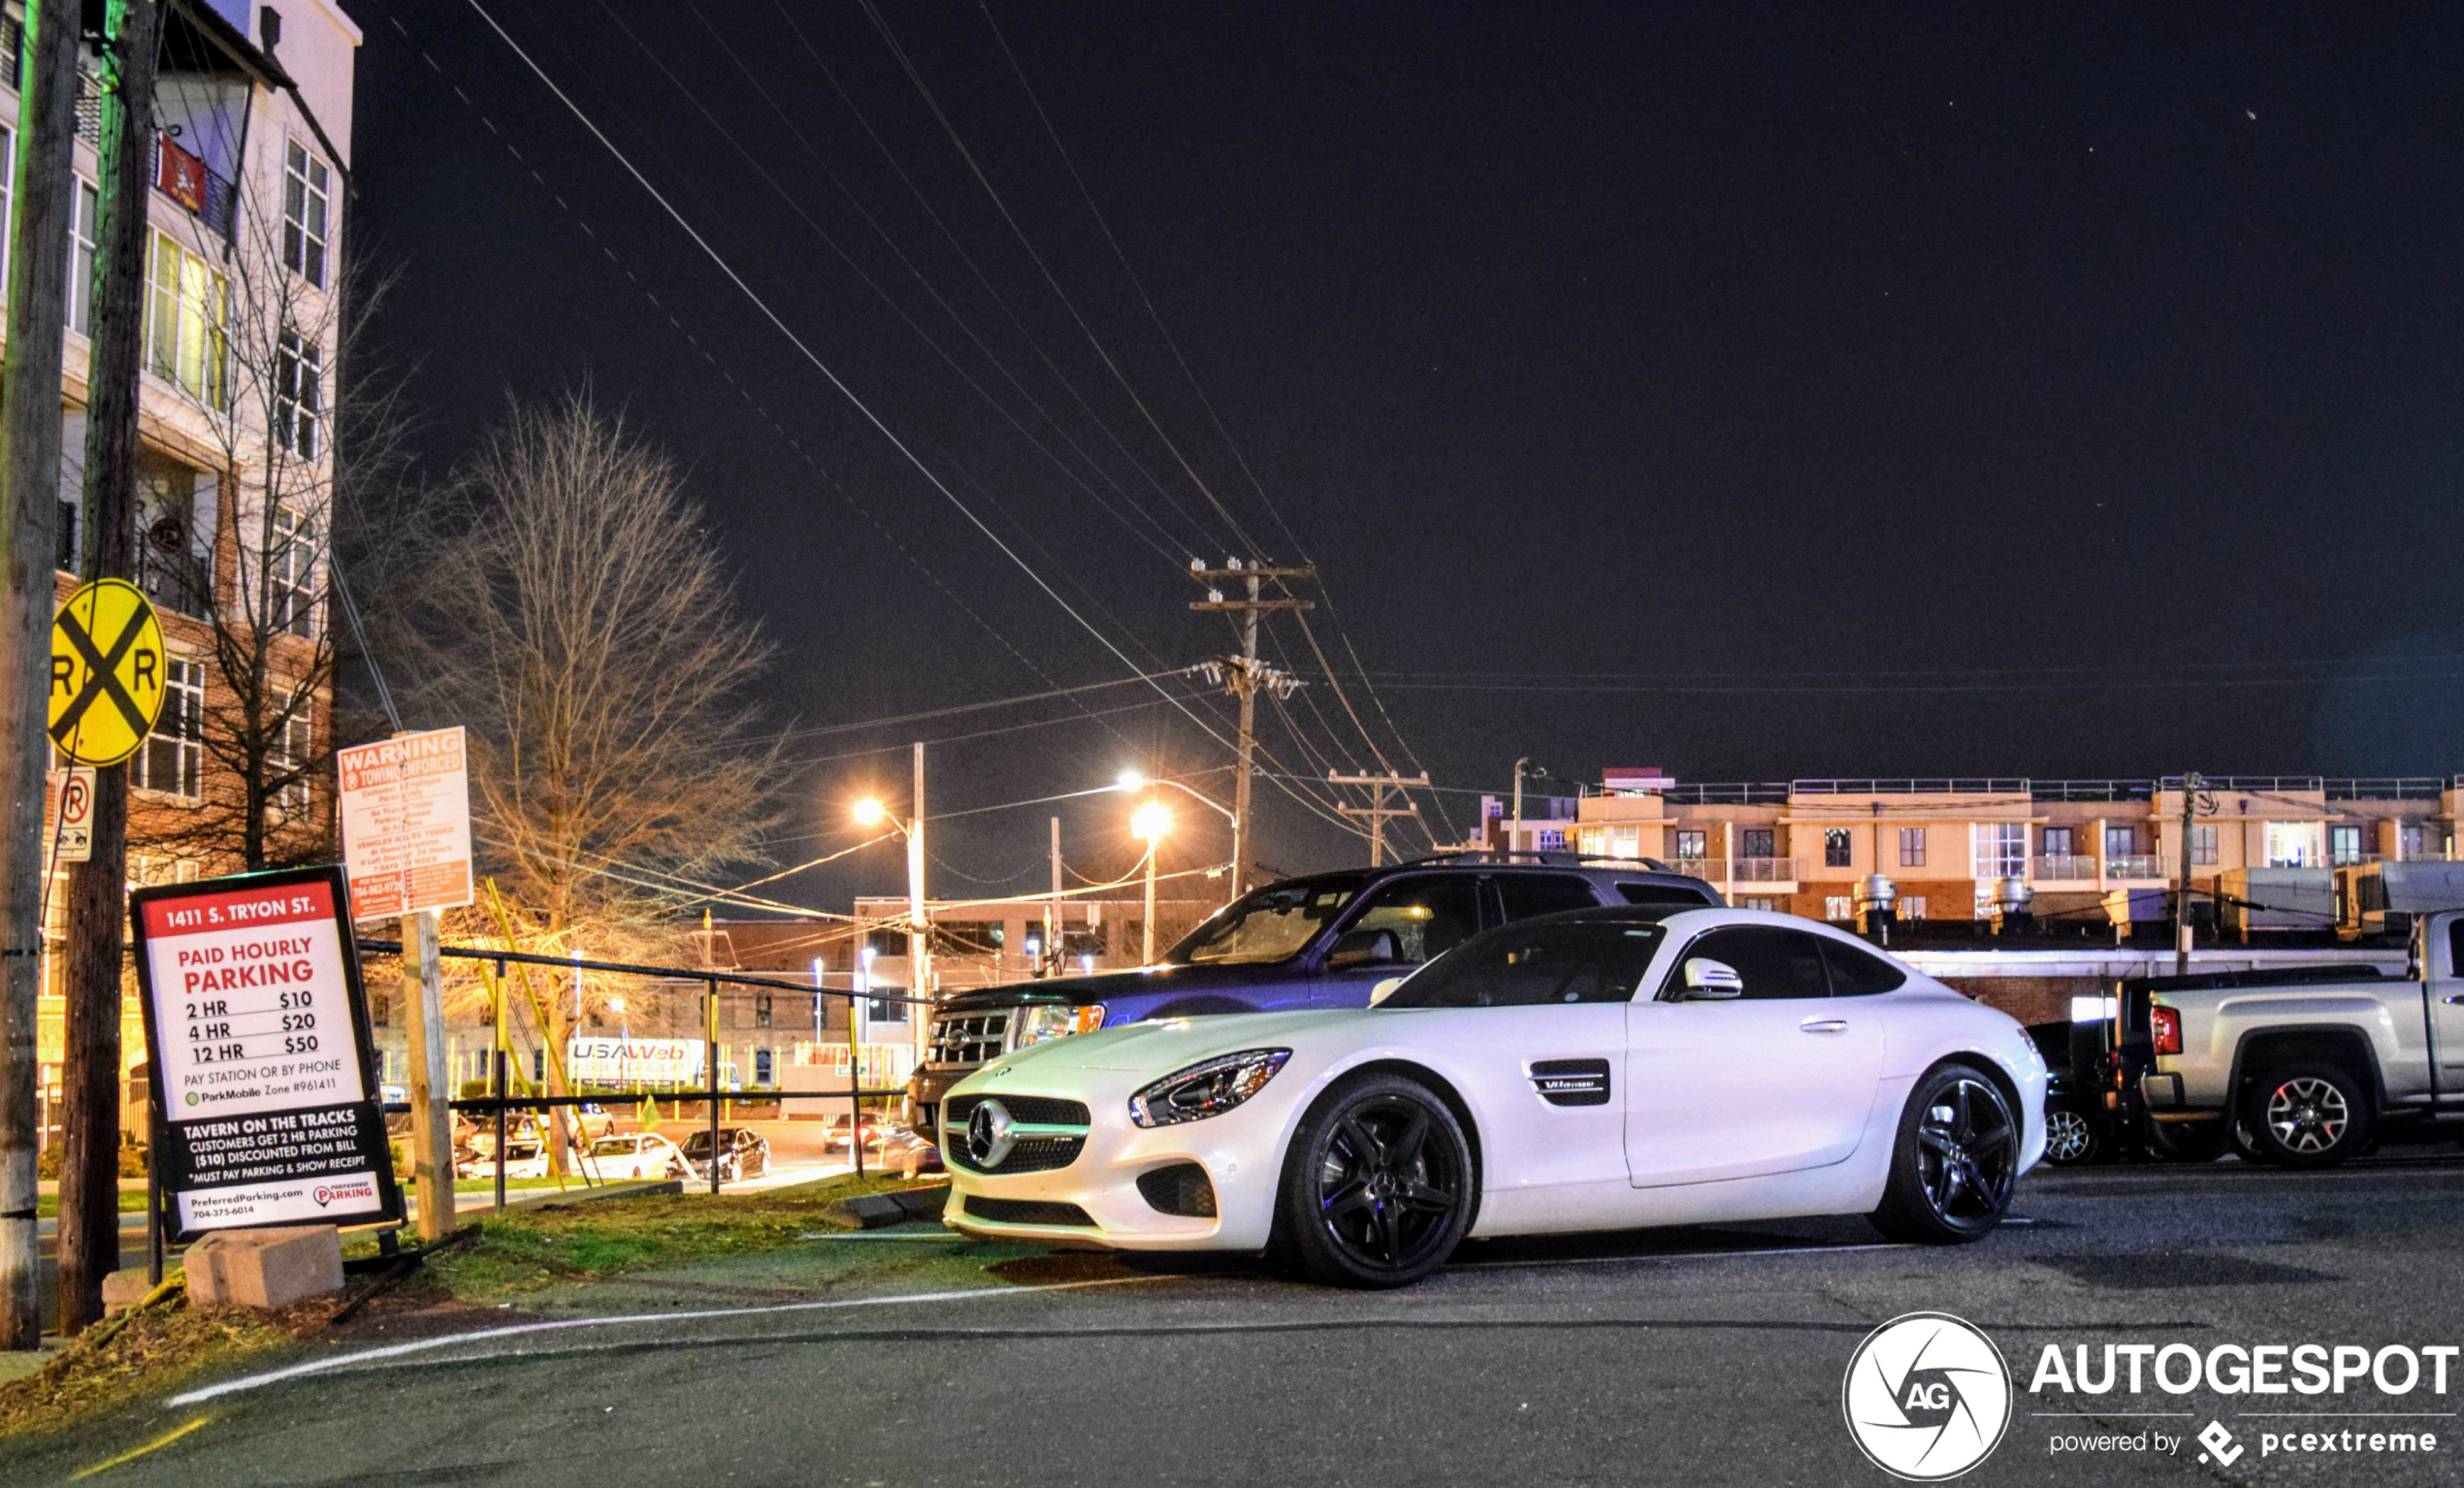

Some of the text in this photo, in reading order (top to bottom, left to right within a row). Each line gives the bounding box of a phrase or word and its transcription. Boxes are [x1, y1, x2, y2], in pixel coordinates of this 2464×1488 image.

[133, 648, 157, 692] R
[343, 734, 460, 772] WARNING
[402, 753, 460, 778] ENFORCED
[357, 837, 392, 849] VEHICLES
[426, 826, 454, 837] TOWED
[167, 896, 316, 927] 1411 S. TRYON ST.
[178, 937, 312, 967] PAID HOURLY
[184, 959, 313, 994] PARKING
[185, 990, 312, 1019] 2 HR $10
[188, 1013, 315, 1041] 4 HR $20
[193, 1035, 318, 1063] 12 HR $50
[573, 1044, 684, 1060] USAWeb
[184, 1058, 341, 1086] PAY STATION OR BY PHONE
[202, 1078, 336, 1103] ParkMobile Zone #961411
[183, 1109, 356, 1140] TAVERN ON THE TRACKS
[189, 1125, 358, 1153] CUSTOMERS GET 2 HR PARKING
[195, 1140, 357, 1169] ($10) DISCOUNTED FROM BILL
[222, 1169, 241, 1181] PAY
[242, 1164, 284, 1179] PARKING
[286, 1163, 294, 1174] &
[296, 1159, 327, 1173] SHOW
[329, 1155, 366, 1169] RECEIPT
[191, 1189, 304, 1208] PreferredParking.com
[193, 1206, 254, 1219] 704-375-6014
